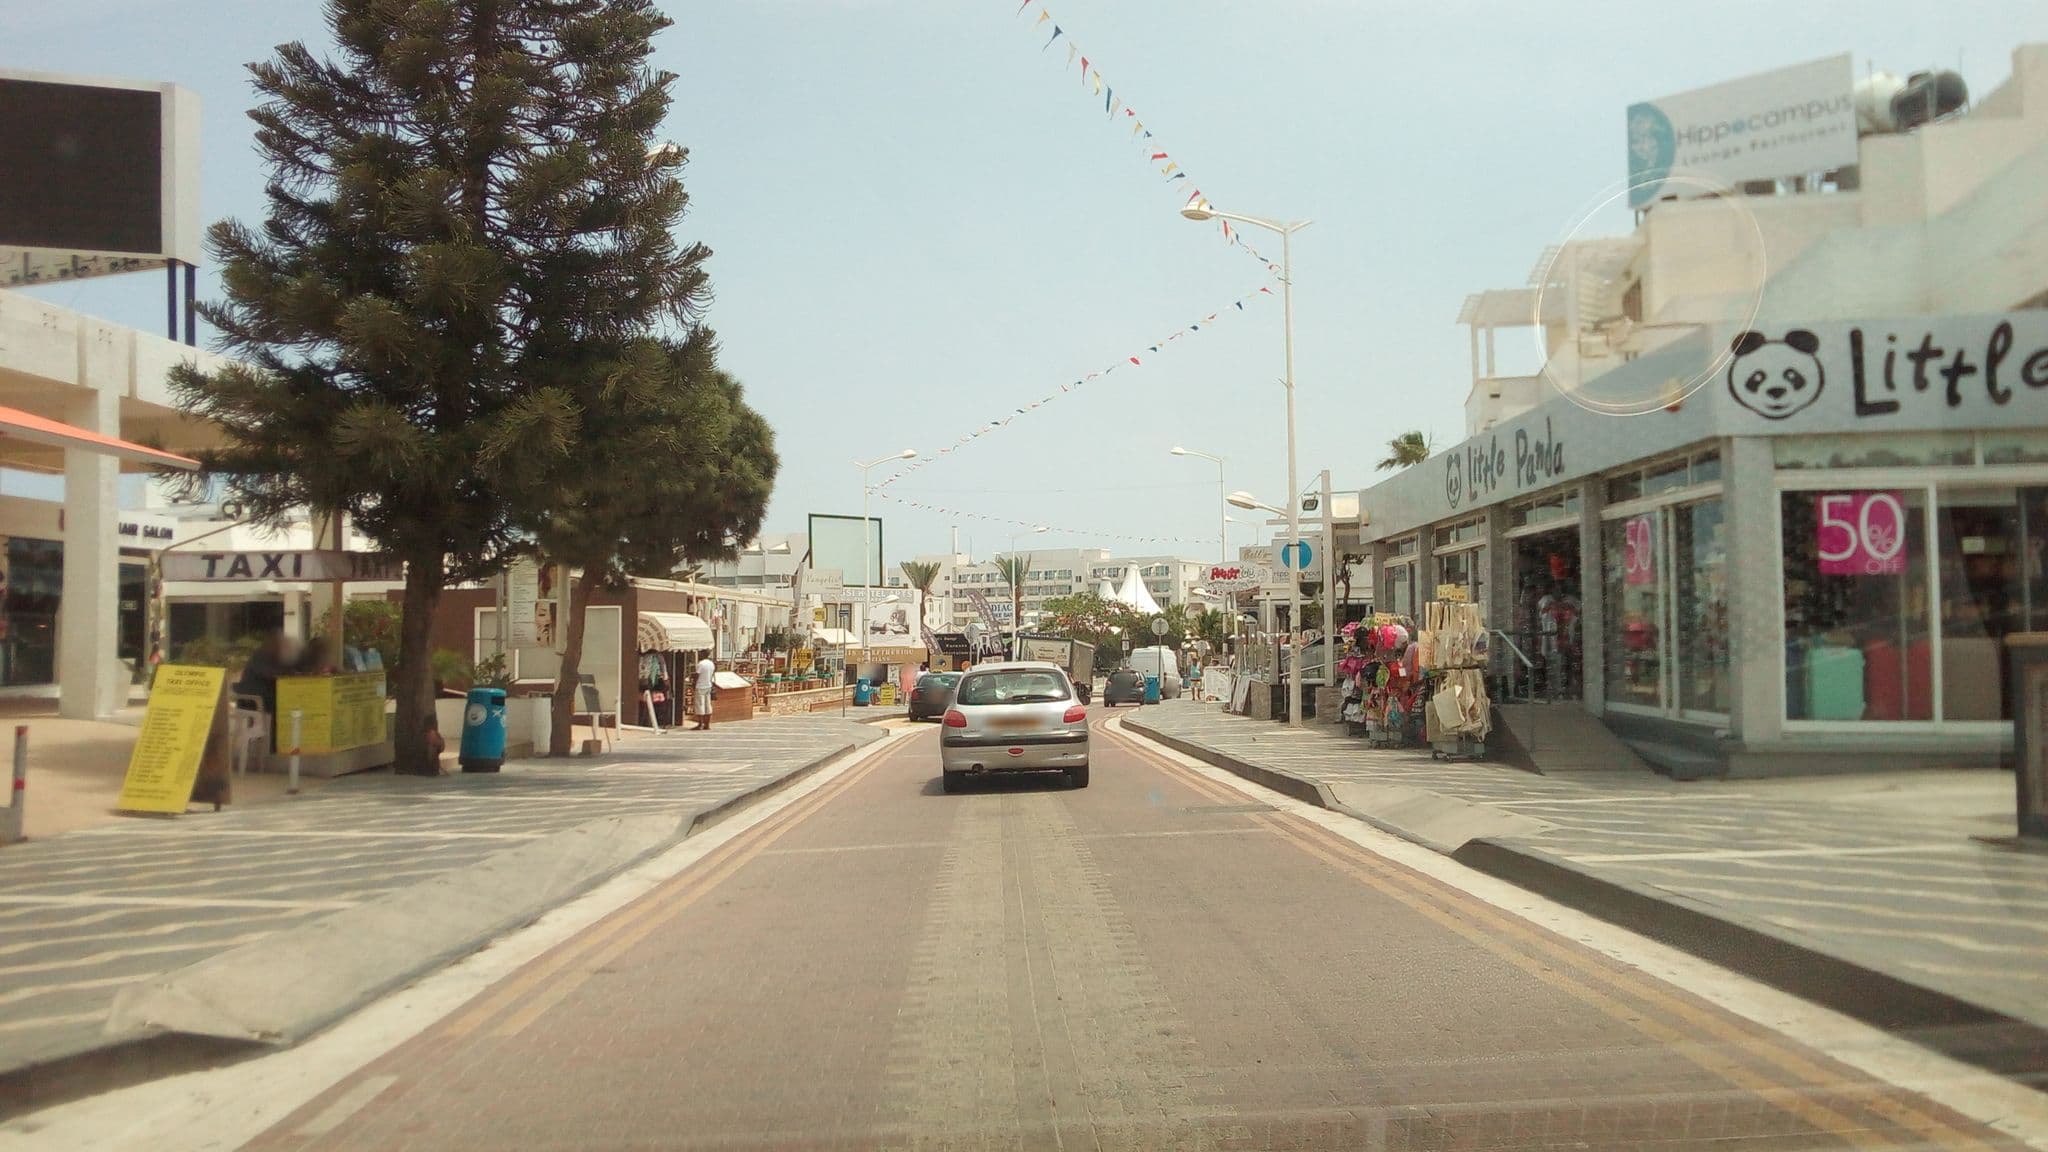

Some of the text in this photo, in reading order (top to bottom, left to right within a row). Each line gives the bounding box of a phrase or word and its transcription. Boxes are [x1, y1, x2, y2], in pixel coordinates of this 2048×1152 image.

[1677, 95, 1853, 147] Hippocampus
[1467, 416, 1565, 502] Little Panda
[143, 524, 173, 540] SALON
[1626, 517, 1650, 572] 50
[1818, 493, 1905, 561] 50
[201, 552, 304, 579] TAXI
[1864, 558, 1906, 575] OFF
